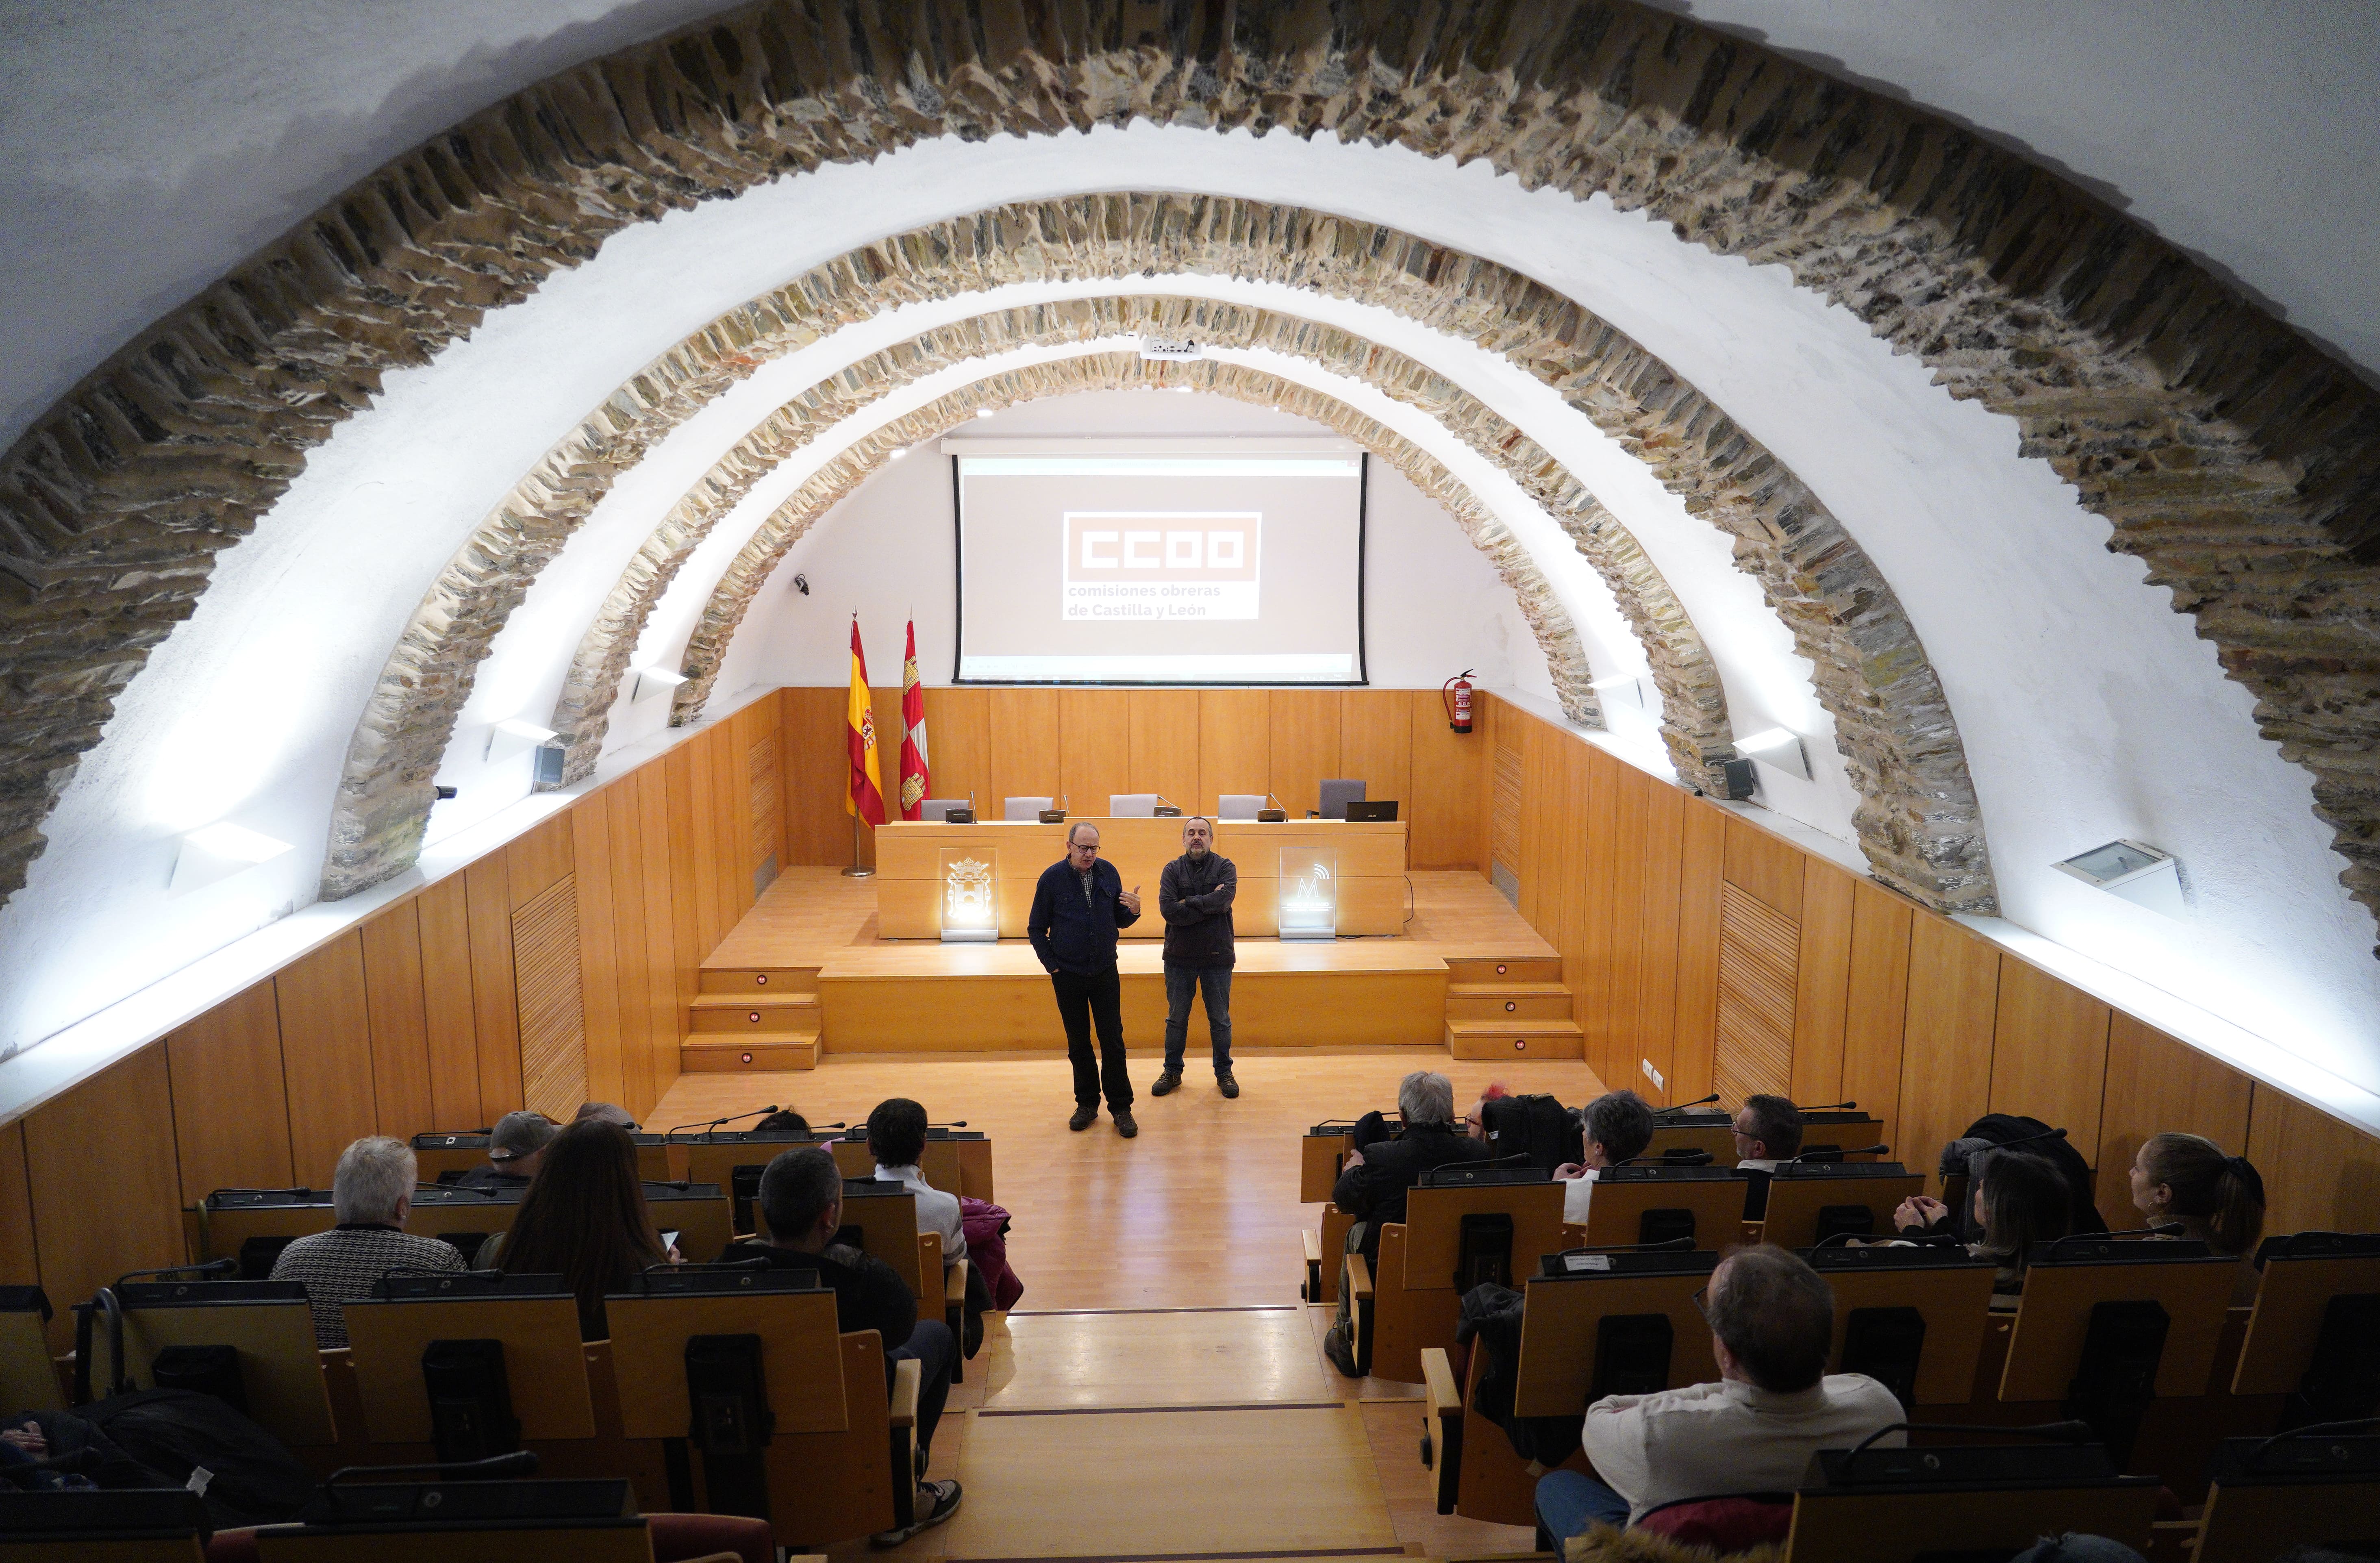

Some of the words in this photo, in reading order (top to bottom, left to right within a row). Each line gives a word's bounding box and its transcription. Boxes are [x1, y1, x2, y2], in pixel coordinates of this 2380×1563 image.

[1082, 531, 1244, 568] CCOO
[1068, 585, 1156, 596] comisiones
[1161, 584, 1221, 596] obreras
[1068, 604, 1088, 616] de
[1092, 604, 1152, 616] Castilla
[1156, 607, 1165, 619] y
[1168, 603, 1206, 616] León
